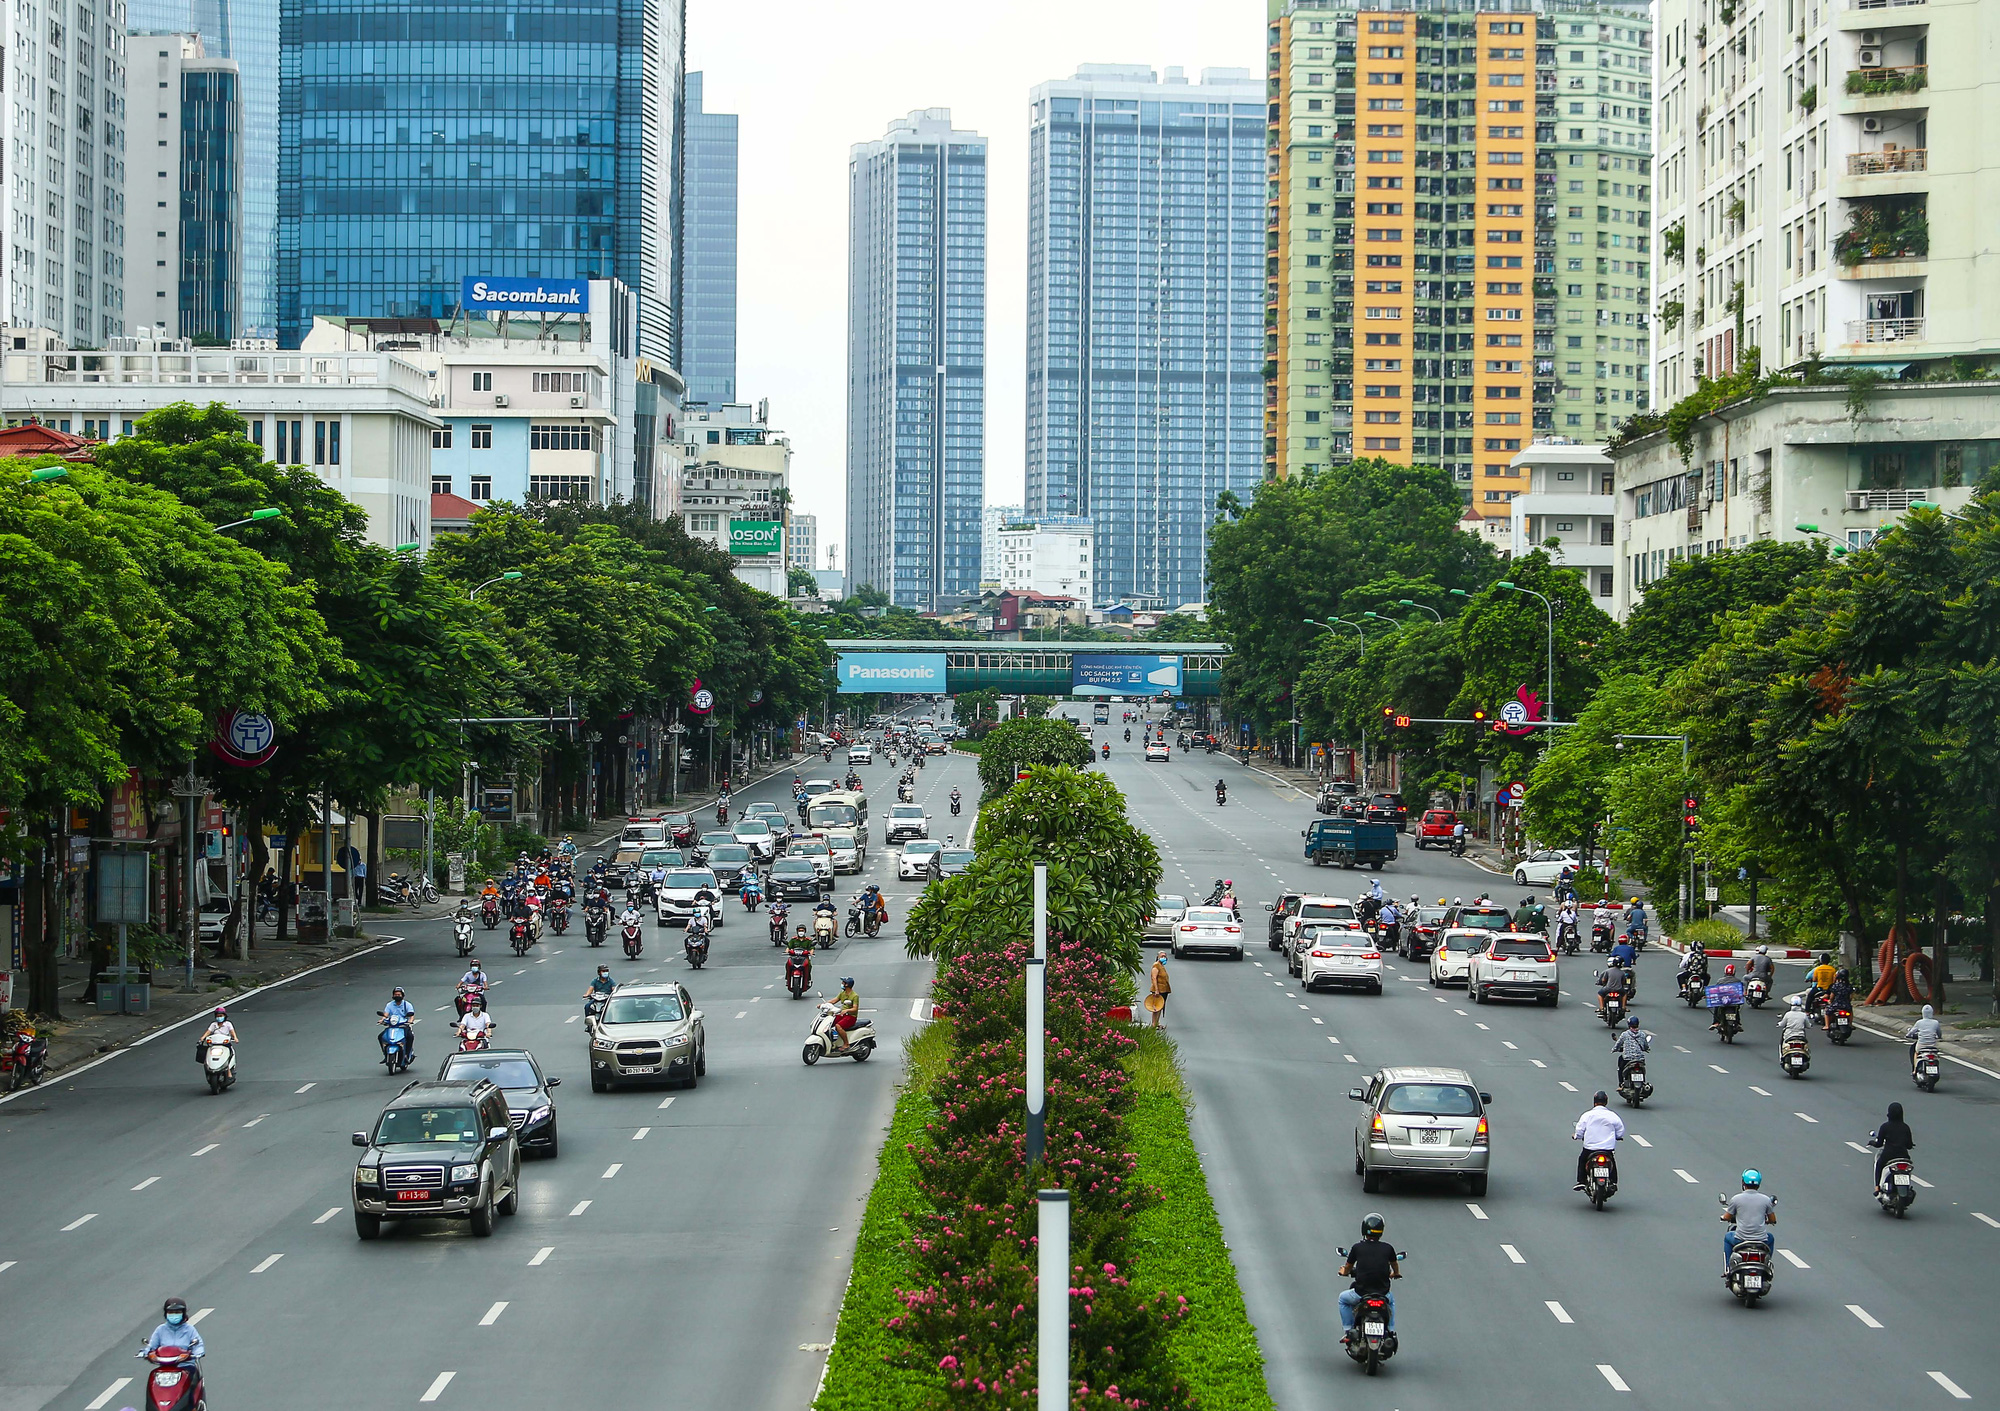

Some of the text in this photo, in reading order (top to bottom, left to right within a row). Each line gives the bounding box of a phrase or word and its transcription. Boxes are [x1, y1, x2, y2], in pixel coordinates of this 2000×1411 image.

[472, 282, 581, 304] Sacombank
[849, 664, 935, 679] Panasonic
[1396, 716, 1410, 727] 00
[1493, 720, 1507, 731] 24
